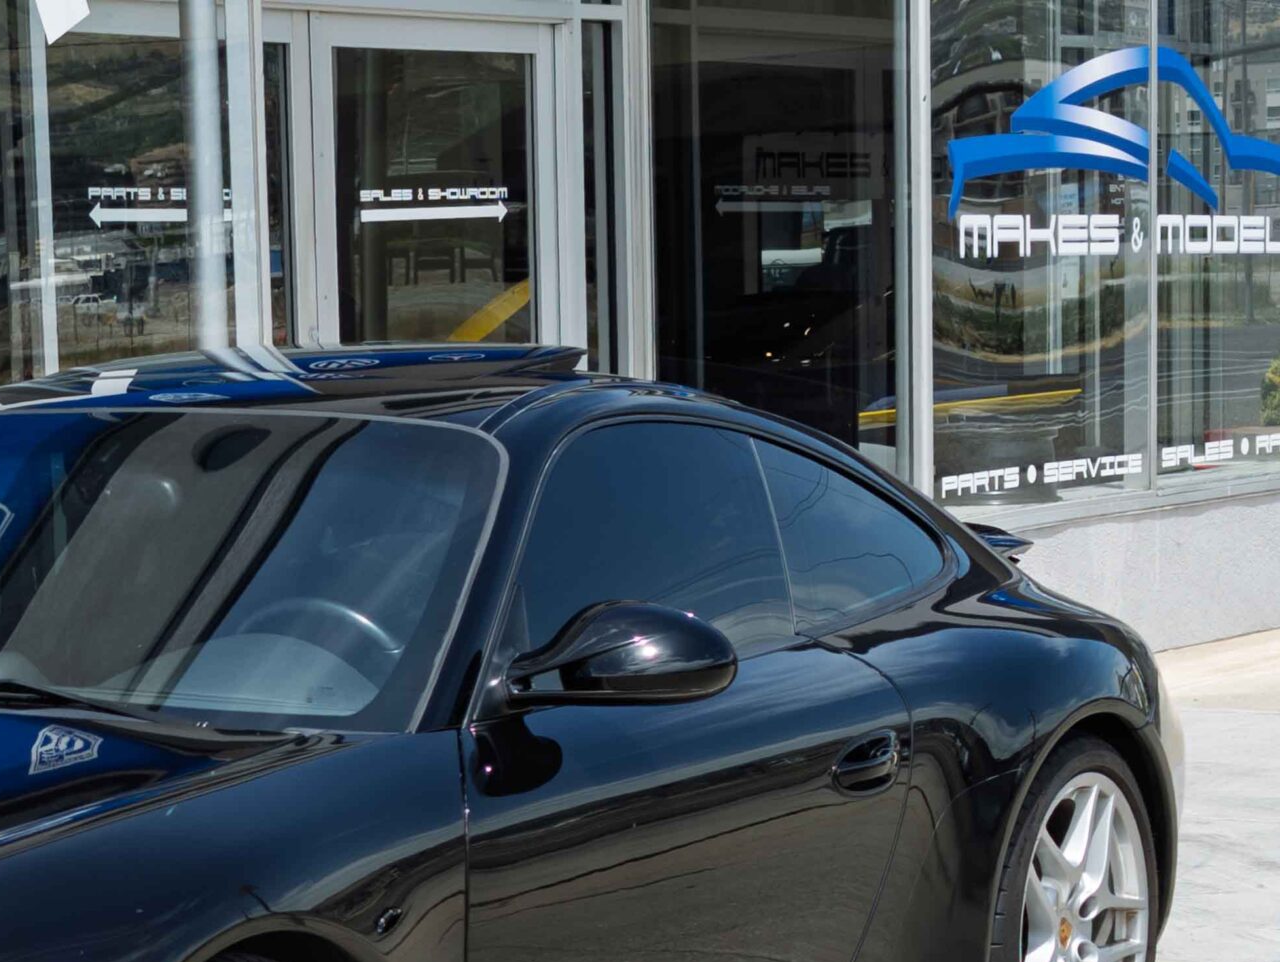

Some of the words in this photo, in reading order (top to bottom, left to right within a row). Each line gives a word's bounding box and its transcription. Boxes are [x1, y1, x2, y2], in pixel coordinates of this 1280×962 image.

[756, 149, 872, 179] MAKES
[88, 187, 151, 200] PARTS
[157, 187, 165, 200] &
[360, 189, 413, 202] SALES
[428, 187, 508, 200] SHOWROOM
[959, 214, 1120, 258] MAKES
[1131, 217, 1143, 252] &
[941, 467, 1020, 498] PARTS
[1043, 453, 1142, 483] SERVICE
[1162, 440, 1234, 468] SALES
